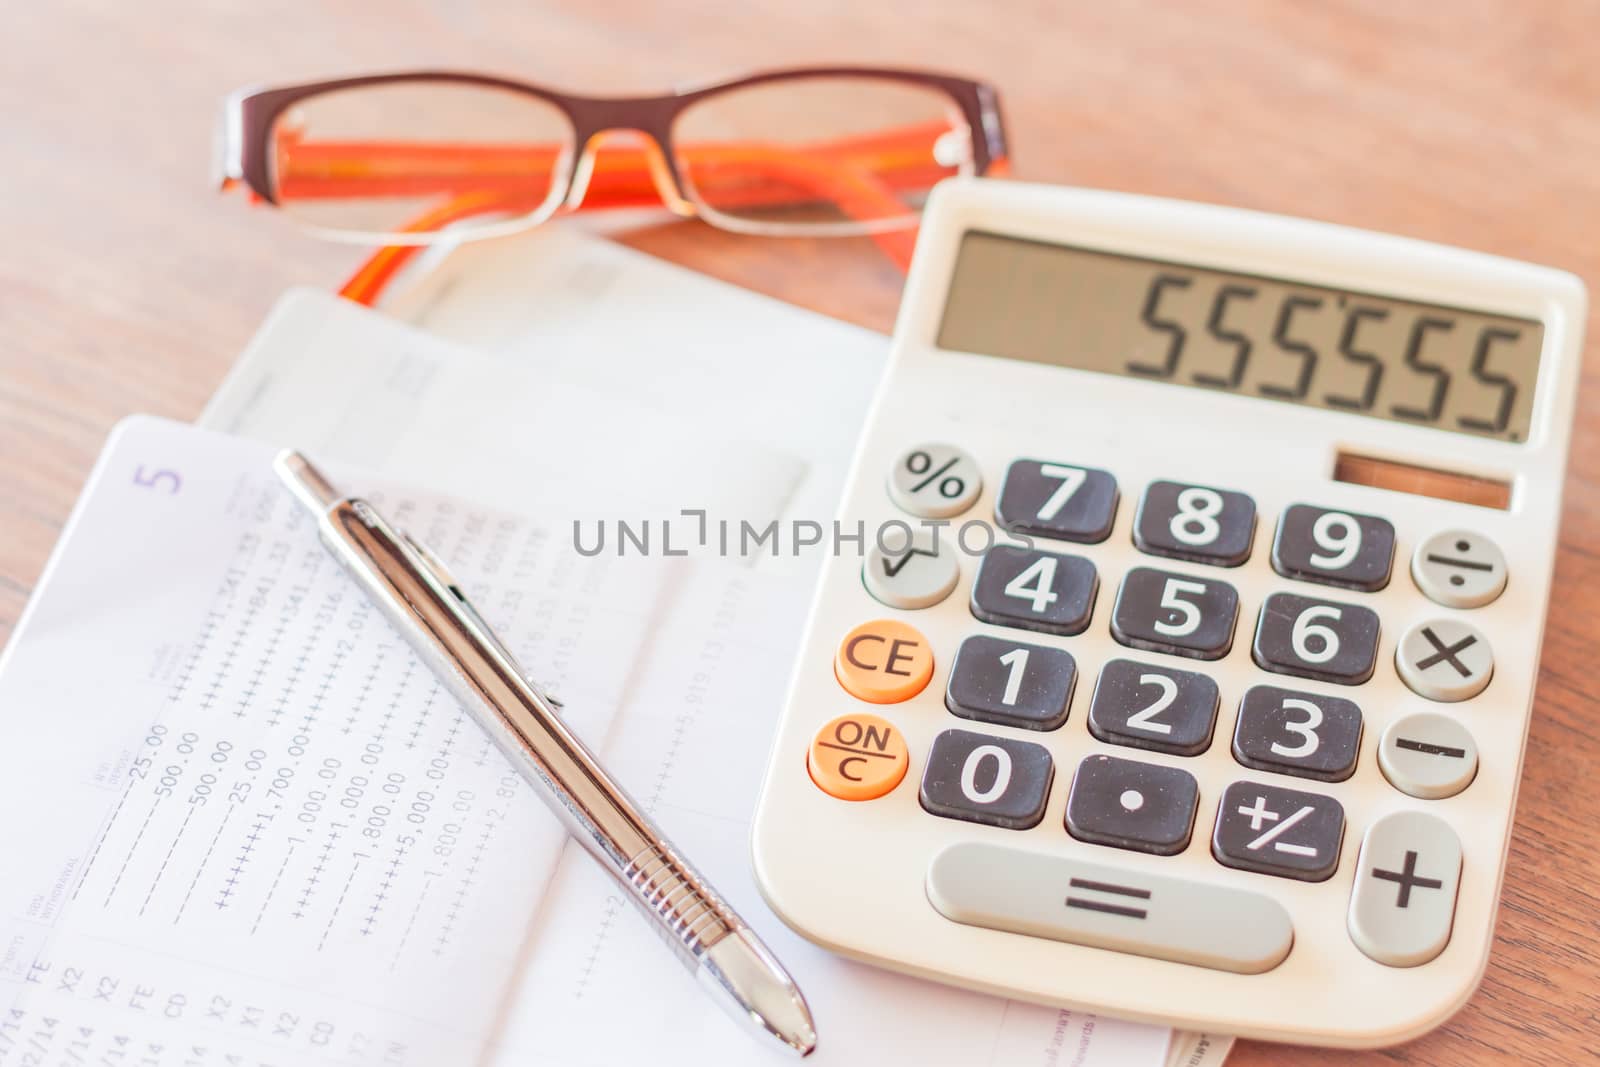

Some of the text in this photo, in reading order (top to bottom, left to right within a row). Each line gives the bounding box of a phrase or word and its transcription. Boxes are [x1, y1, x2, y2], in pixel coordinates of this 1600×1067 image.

[133, 465, 182, 494] 5
[1039, 463, 1087, 520] 7
[1170, 487, 1224, 546] 8
[1309, 512, 1362, 570] 9
[1004, 556, 1058, 613] 4
[1153, 578, 1208, 637] 5
[845, 634, 919, 677] CE
[1291, 605, 1342, 664] 6
[999, 648, 1030, 705] 1
[1126, 673, 1178, 735] 2
[835, 720, 891, 751] ON
[1270, 699, 1323, 758] 3
[838, 756, 868, 782] C
[960, 744, 1012, 804] 0
[26, 959, 51, 984] FE
[57, 967, 84, 992] X2
[93, 976, 120, 1002] X2
[128, 984, 155, 1010] FE
[163, 993, 187, 1018] CD
[205, 995, 232, 1021] X2
[272, 1012, 300, 1038] X2
